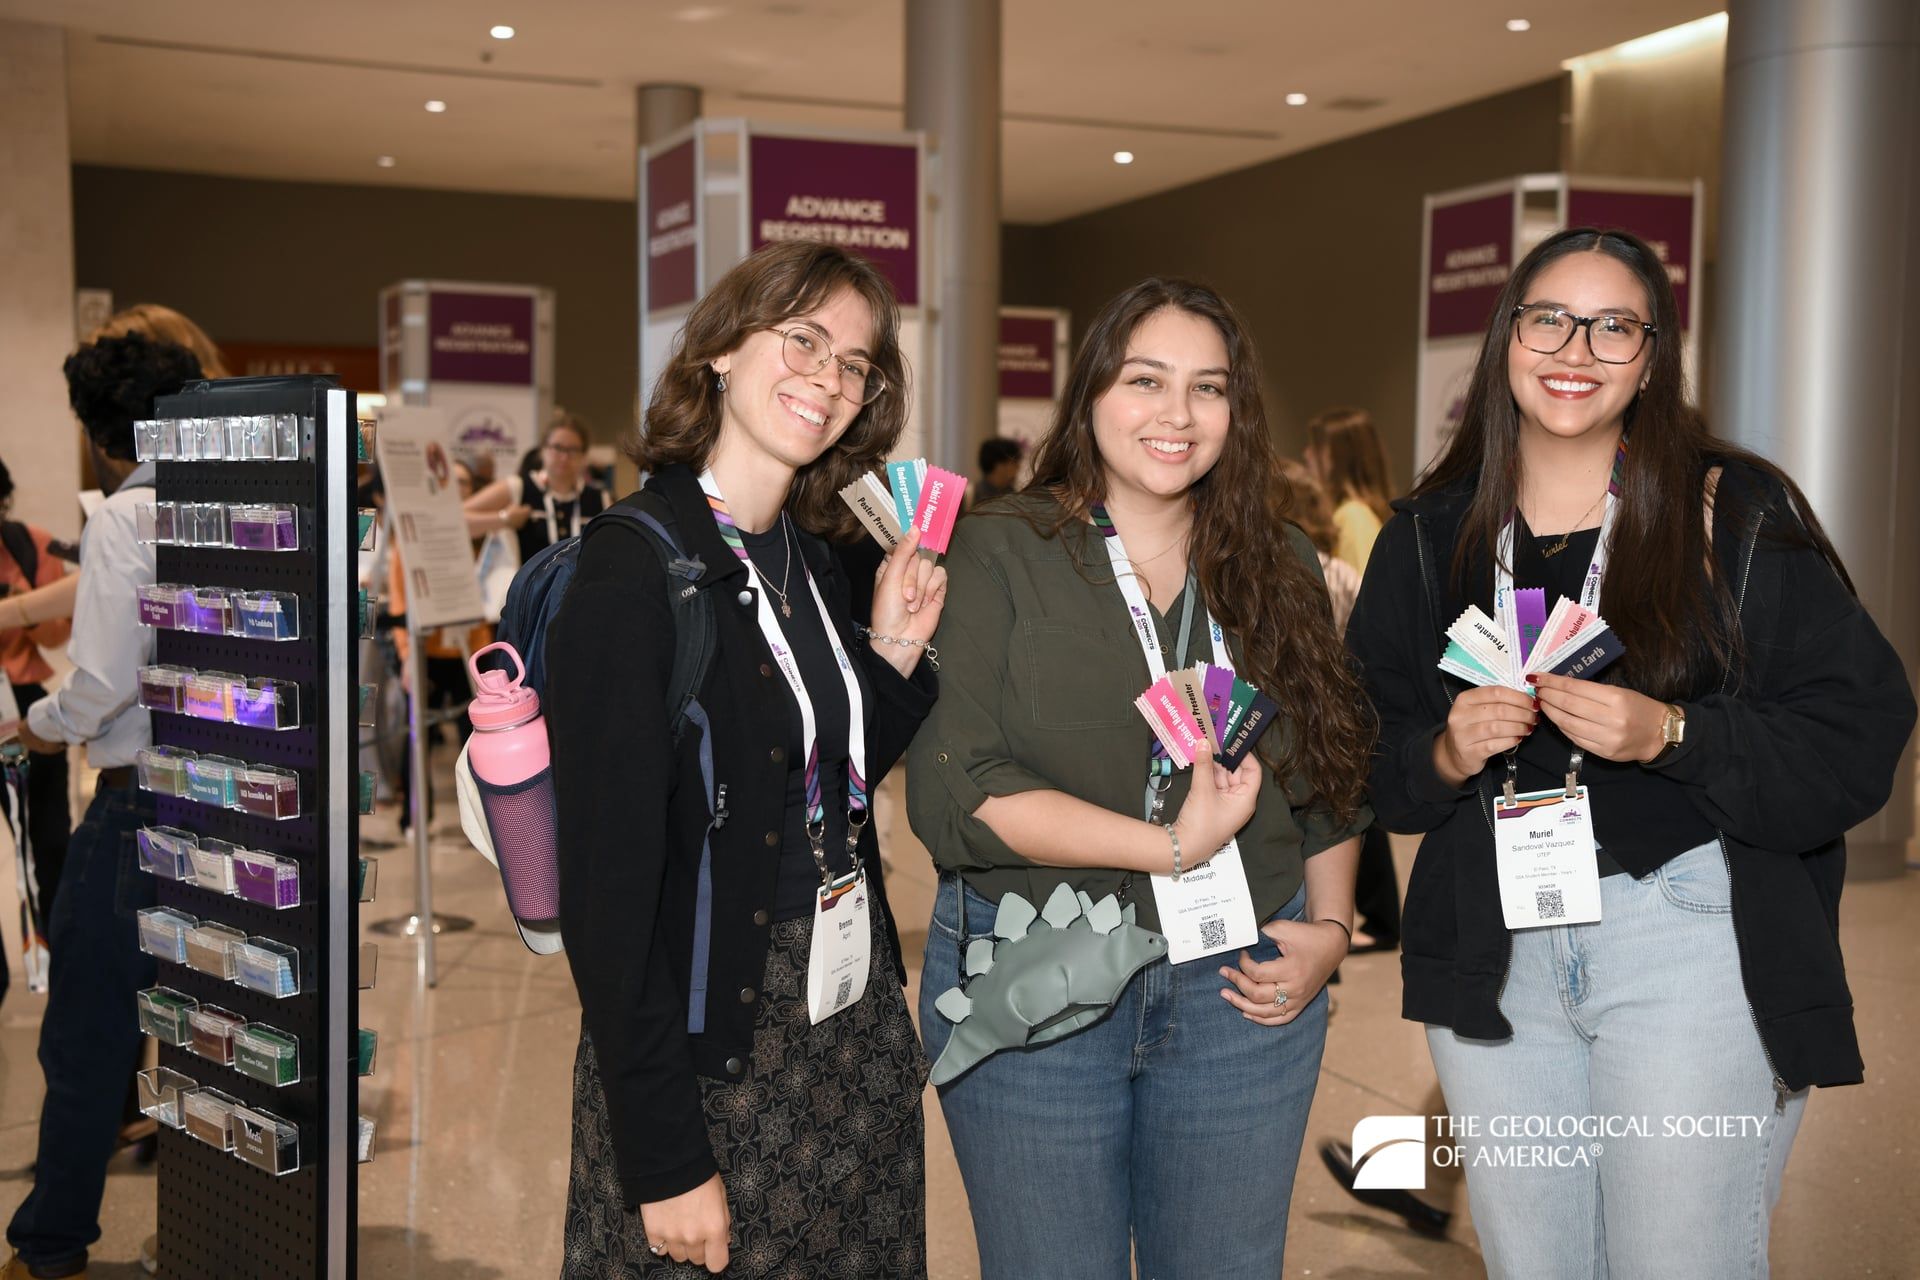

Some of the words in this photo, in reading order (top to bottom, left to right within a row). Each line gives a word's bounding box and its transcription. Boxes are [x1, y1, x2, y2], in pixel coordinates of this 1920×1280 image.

[785, 195, 885, 223] ADVANCE
[759, 222, 910, 250] REGISTRATION
[930, 480, 944, 504] Schist
[857, 497, 875, 518] Poster
[873, 516, 898, 546] Presenter
[920, 503, 938, 533] Happens
[1140, 617, 1155, 650] CONNECTS
[1474, 622, 1505, 653] Presenter
[1574, 662, 1584, 674] to
[1581, 647, 1606, 667] Earth
[1160, 695, 1182, 726] Happens
[1185, 683, 1201, 717] Presenter
[1178, 721, 1198, 747] Schist
[1196, 714, 1208, 739] oster
[1226, 735, 1243, 757] Down
[1238, 727, 1249, 741] to
[1247, 709, 1263, 731] Earth
[1512, 843, 1543, 852] Sandoval
[1546, 839, 1575, 849] Vazquez
[1529, 829, 1553, 840] Muriel
[1183, 871, 1217, 884] Middaugh
